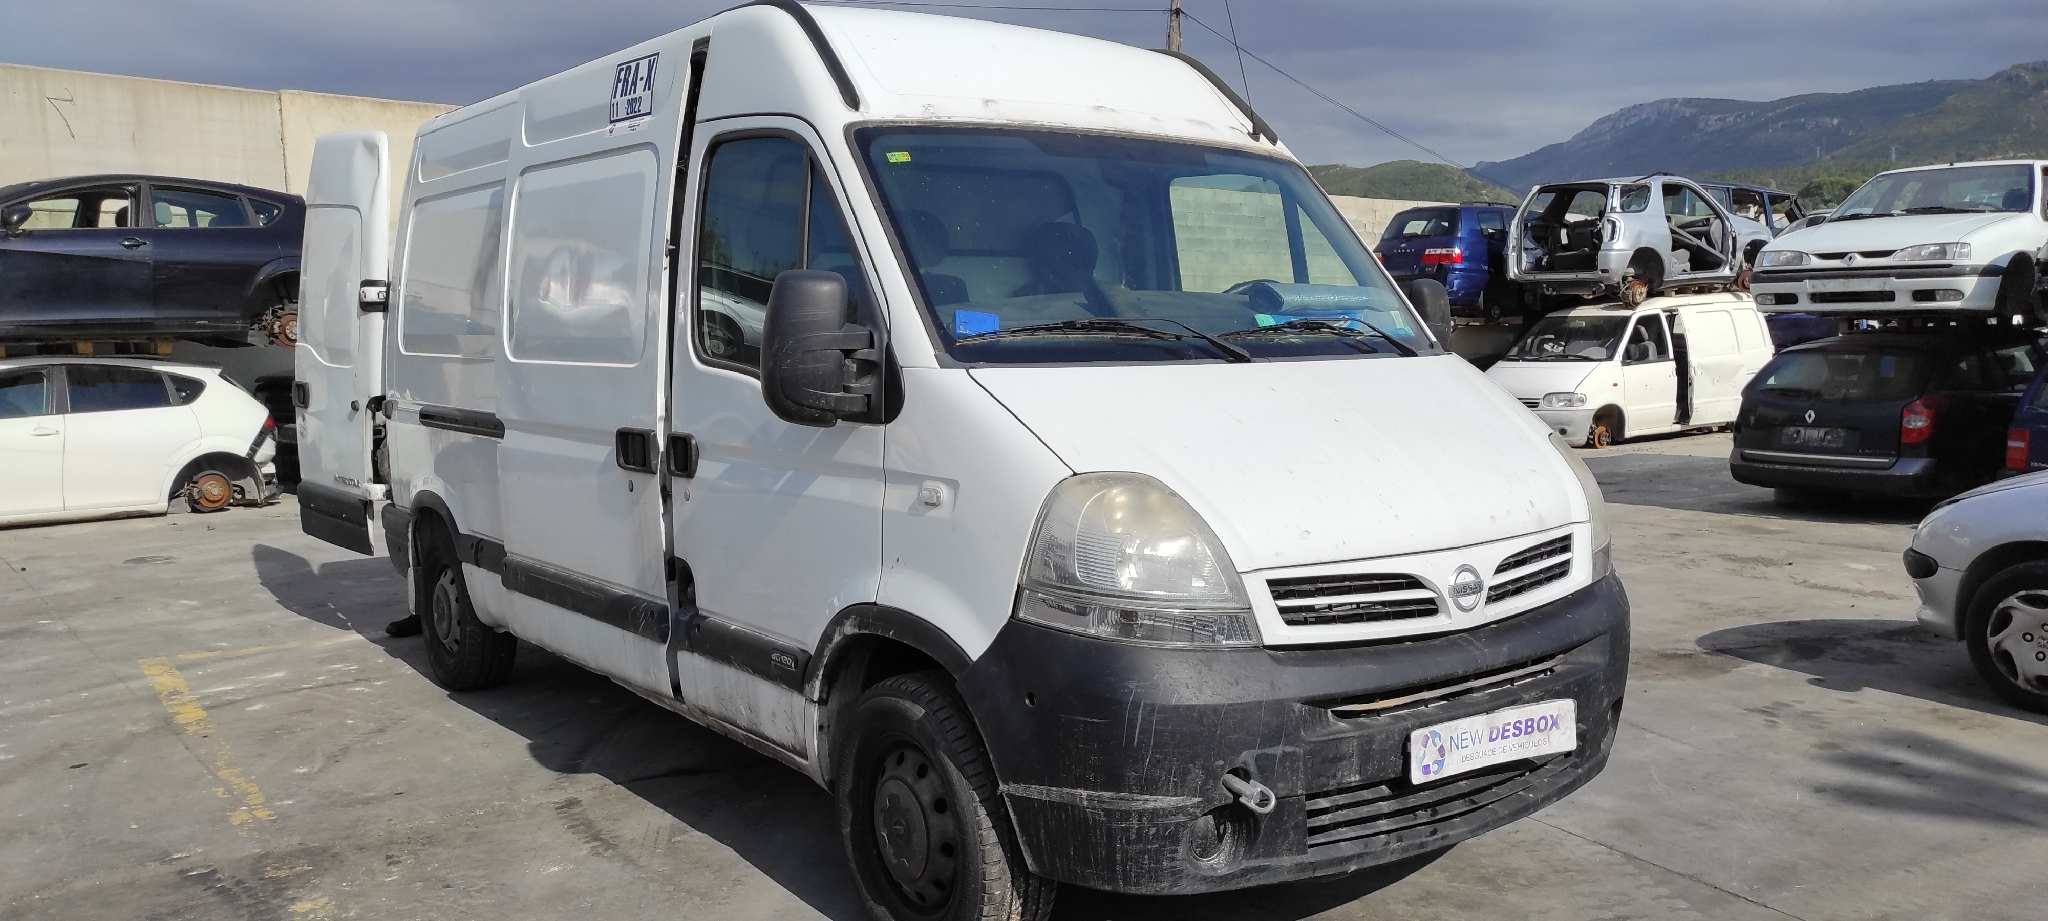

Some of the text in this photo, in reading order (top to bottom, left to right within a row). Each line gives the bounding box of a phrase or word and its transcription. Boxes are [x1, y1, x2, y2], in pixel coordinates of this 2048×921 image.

[613, 57, 656, 99] FRA-X
[1454, 583, 1482, 595] NISSAN
[1449, 712, 1561, 752] NEW DESBOX
